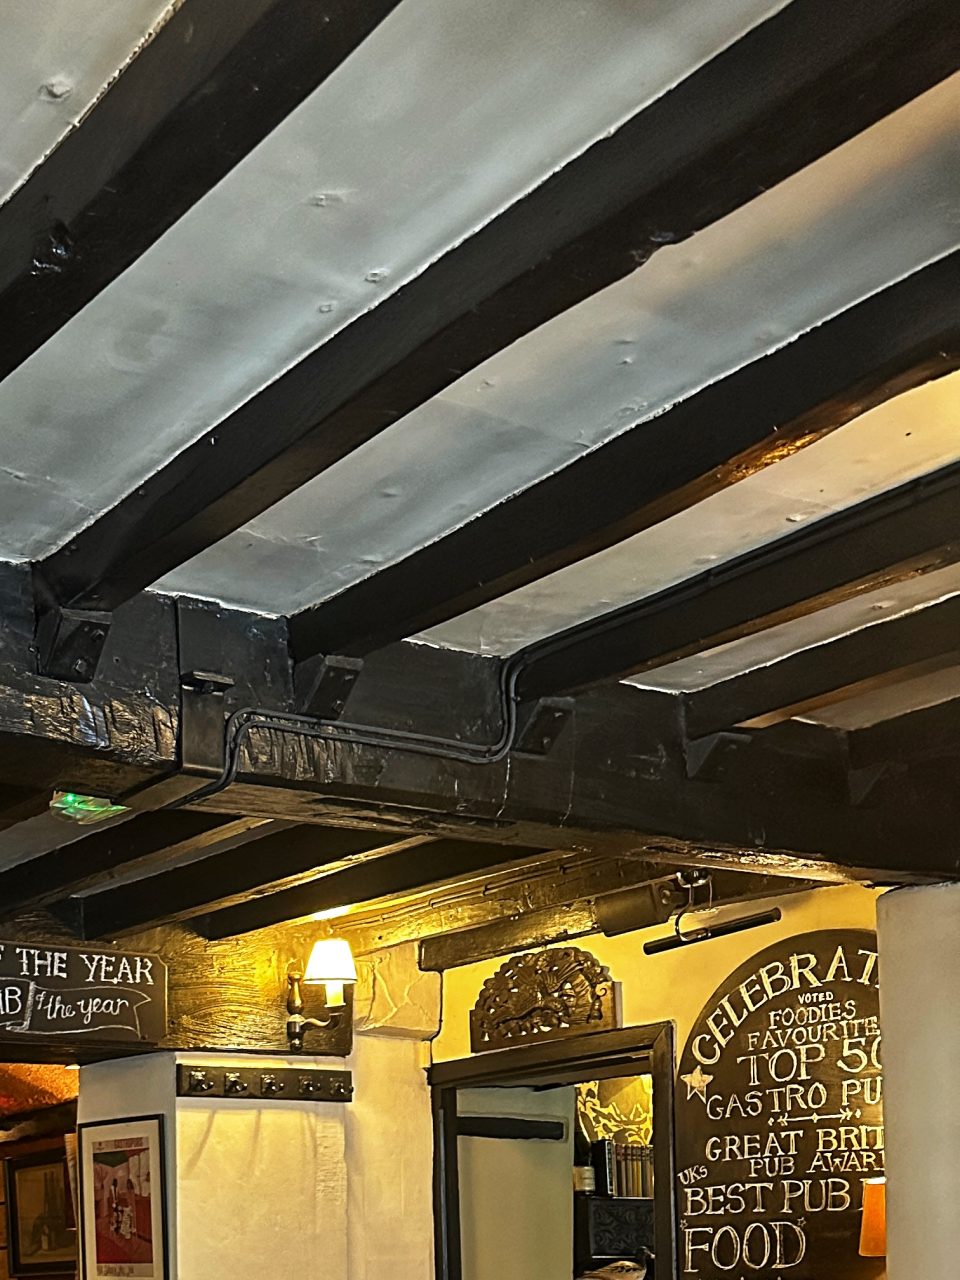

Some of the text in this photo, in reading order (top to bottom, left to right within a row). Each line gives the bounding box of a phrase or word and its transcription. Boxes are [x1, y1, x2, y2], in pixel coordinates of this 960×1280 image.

[16, 947, 68, 979] THE
[79, 954, 155, 986] YEAR
[43, 996, 76, 1020] the
[73, 997, 129, 1024] year
[692, 946, 880, 1065] CELEBRAT
[768, 1000, 856, 1030] FOODIES
[798, 992, 834, 1004] VOTED
[747, 1016, 881, 1051] FAVOURITE
[736, 1043, 826, 1086] TOP
[706, 1082, 827, 1119] GASTRO
[705, 1130, 804, 1162] GREAT
[748, 1156, 795, 1178] PUB
[683, 1182, 774, 1216] BEST
[780, 1178, 851, 1213] PUB
[683, 1221, 807, 1273] FOOD
